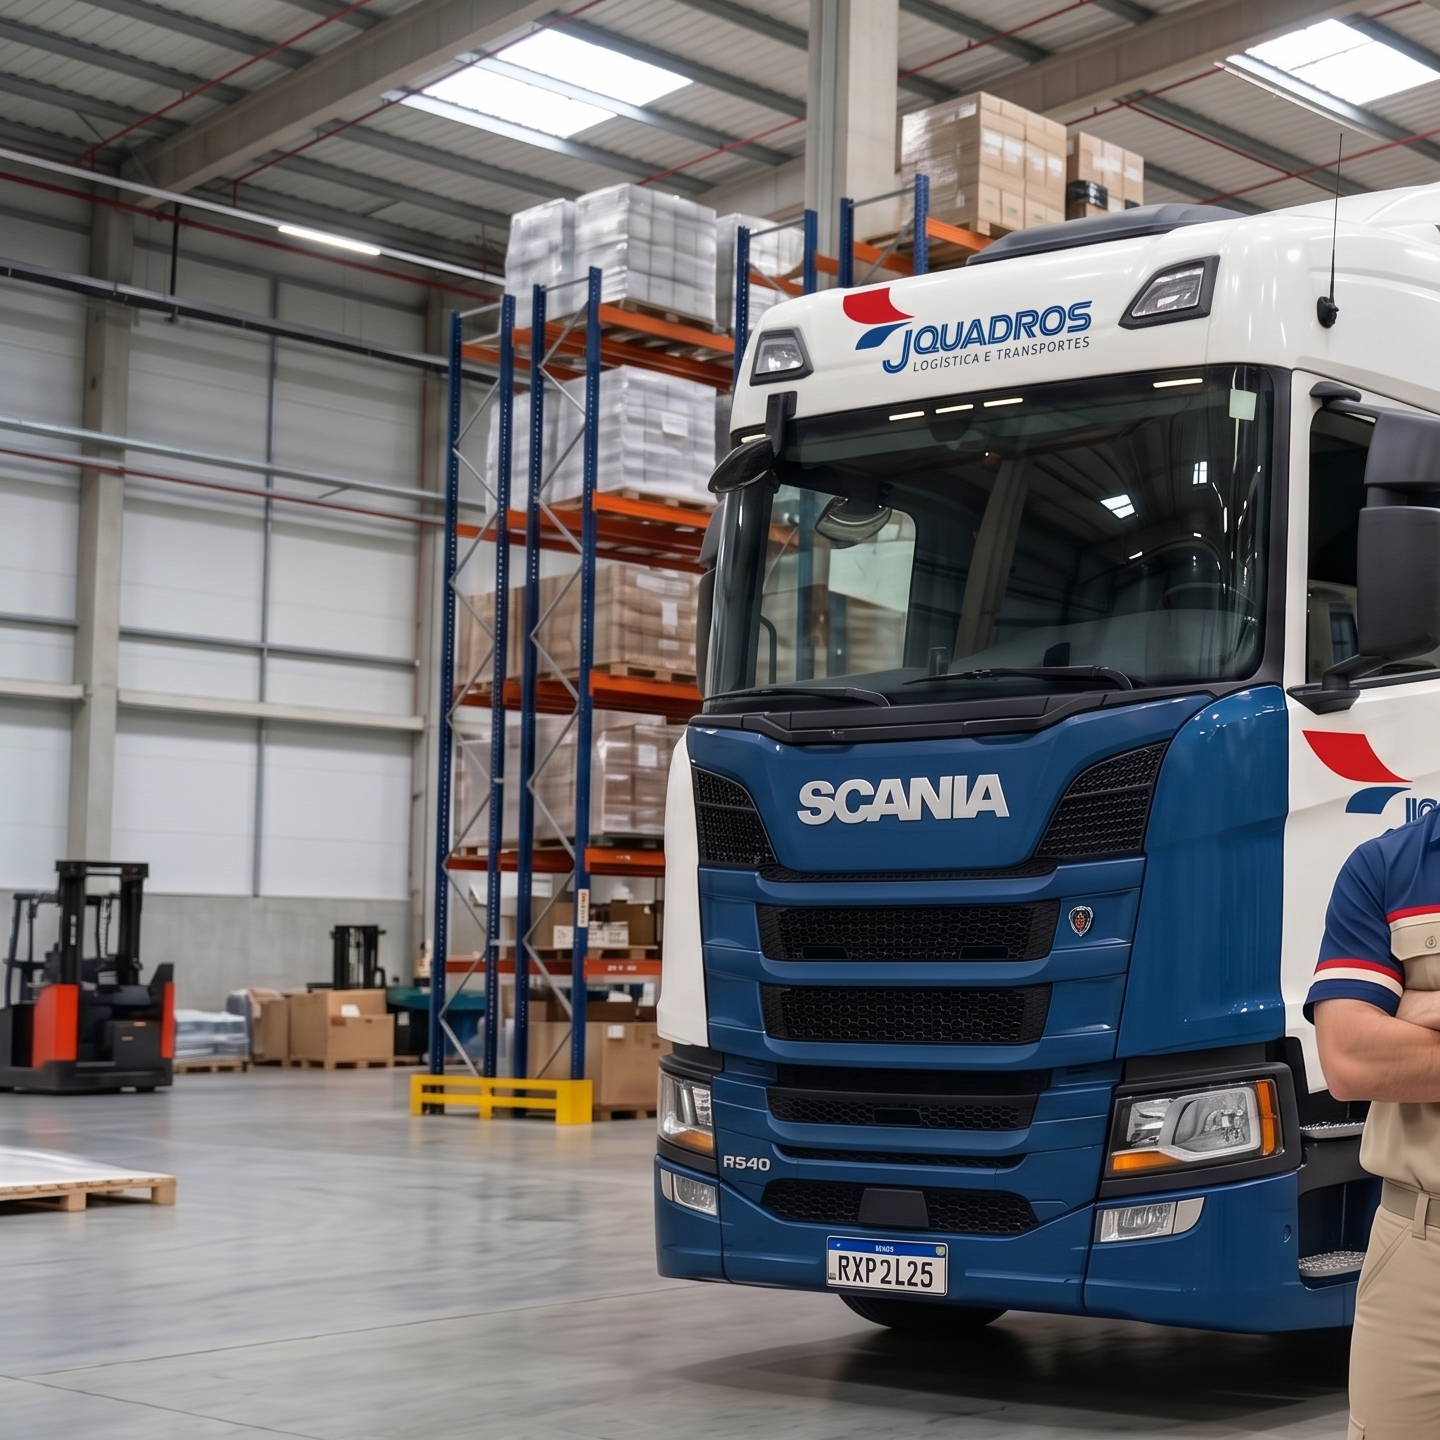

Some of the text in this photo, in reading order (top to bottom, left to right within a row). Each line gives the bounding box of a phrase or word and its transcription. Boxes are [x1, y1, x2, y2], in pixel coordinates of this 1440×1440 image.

[882, 300, 1093, 374] JQUADROS
[913, 336, 1090, 372] LOGÍSTICA E TRANSPORTES
[797, 773, 1010, 825] SCANIA
[723, 1154, 771, 1171] R540
[838, 1254, 933, 1288] RXP2L25
